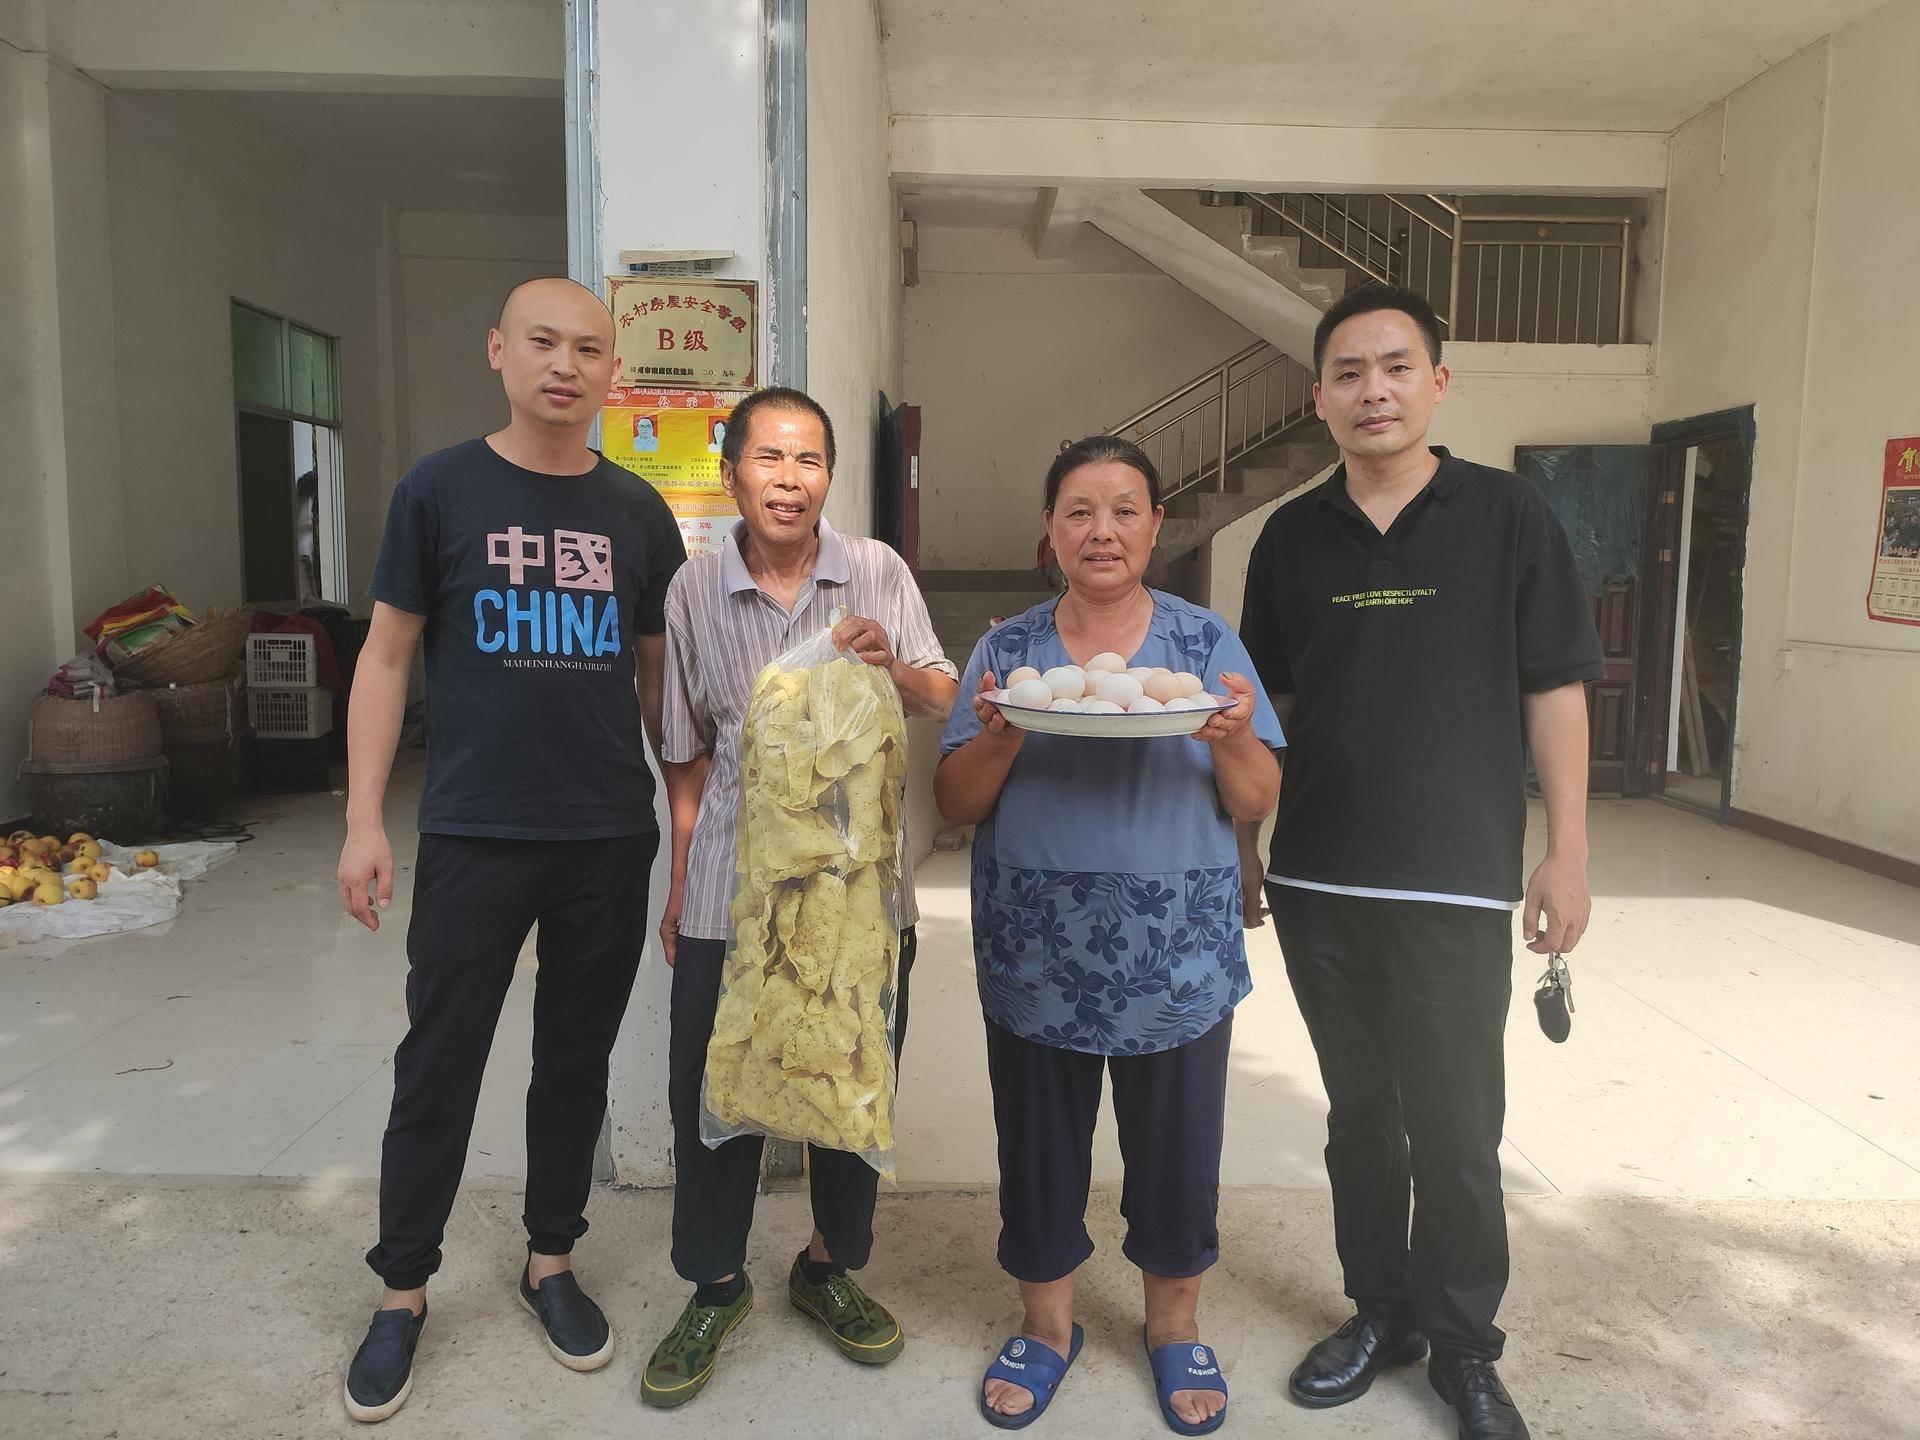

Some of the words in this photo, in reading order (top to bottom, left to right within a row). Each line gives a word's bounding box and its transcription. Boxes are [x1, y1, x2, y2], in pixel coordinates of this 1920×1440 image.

[1332, 595, 1352, 603] PEACE
[1352, 592, 1366, 601] FREE
[1366, 590, 1383, 598] LOVE
[1354, 600, 1365, 609] ONE
[1365, 598, 1384, 606] EARTH
[1384, 598, 1397, 606] ONE
[1397, 597, 1415, 605] HOPE
[474, 589, 621, 658] CHINA
[1000, 1355, 1026, 1370] FASHION
